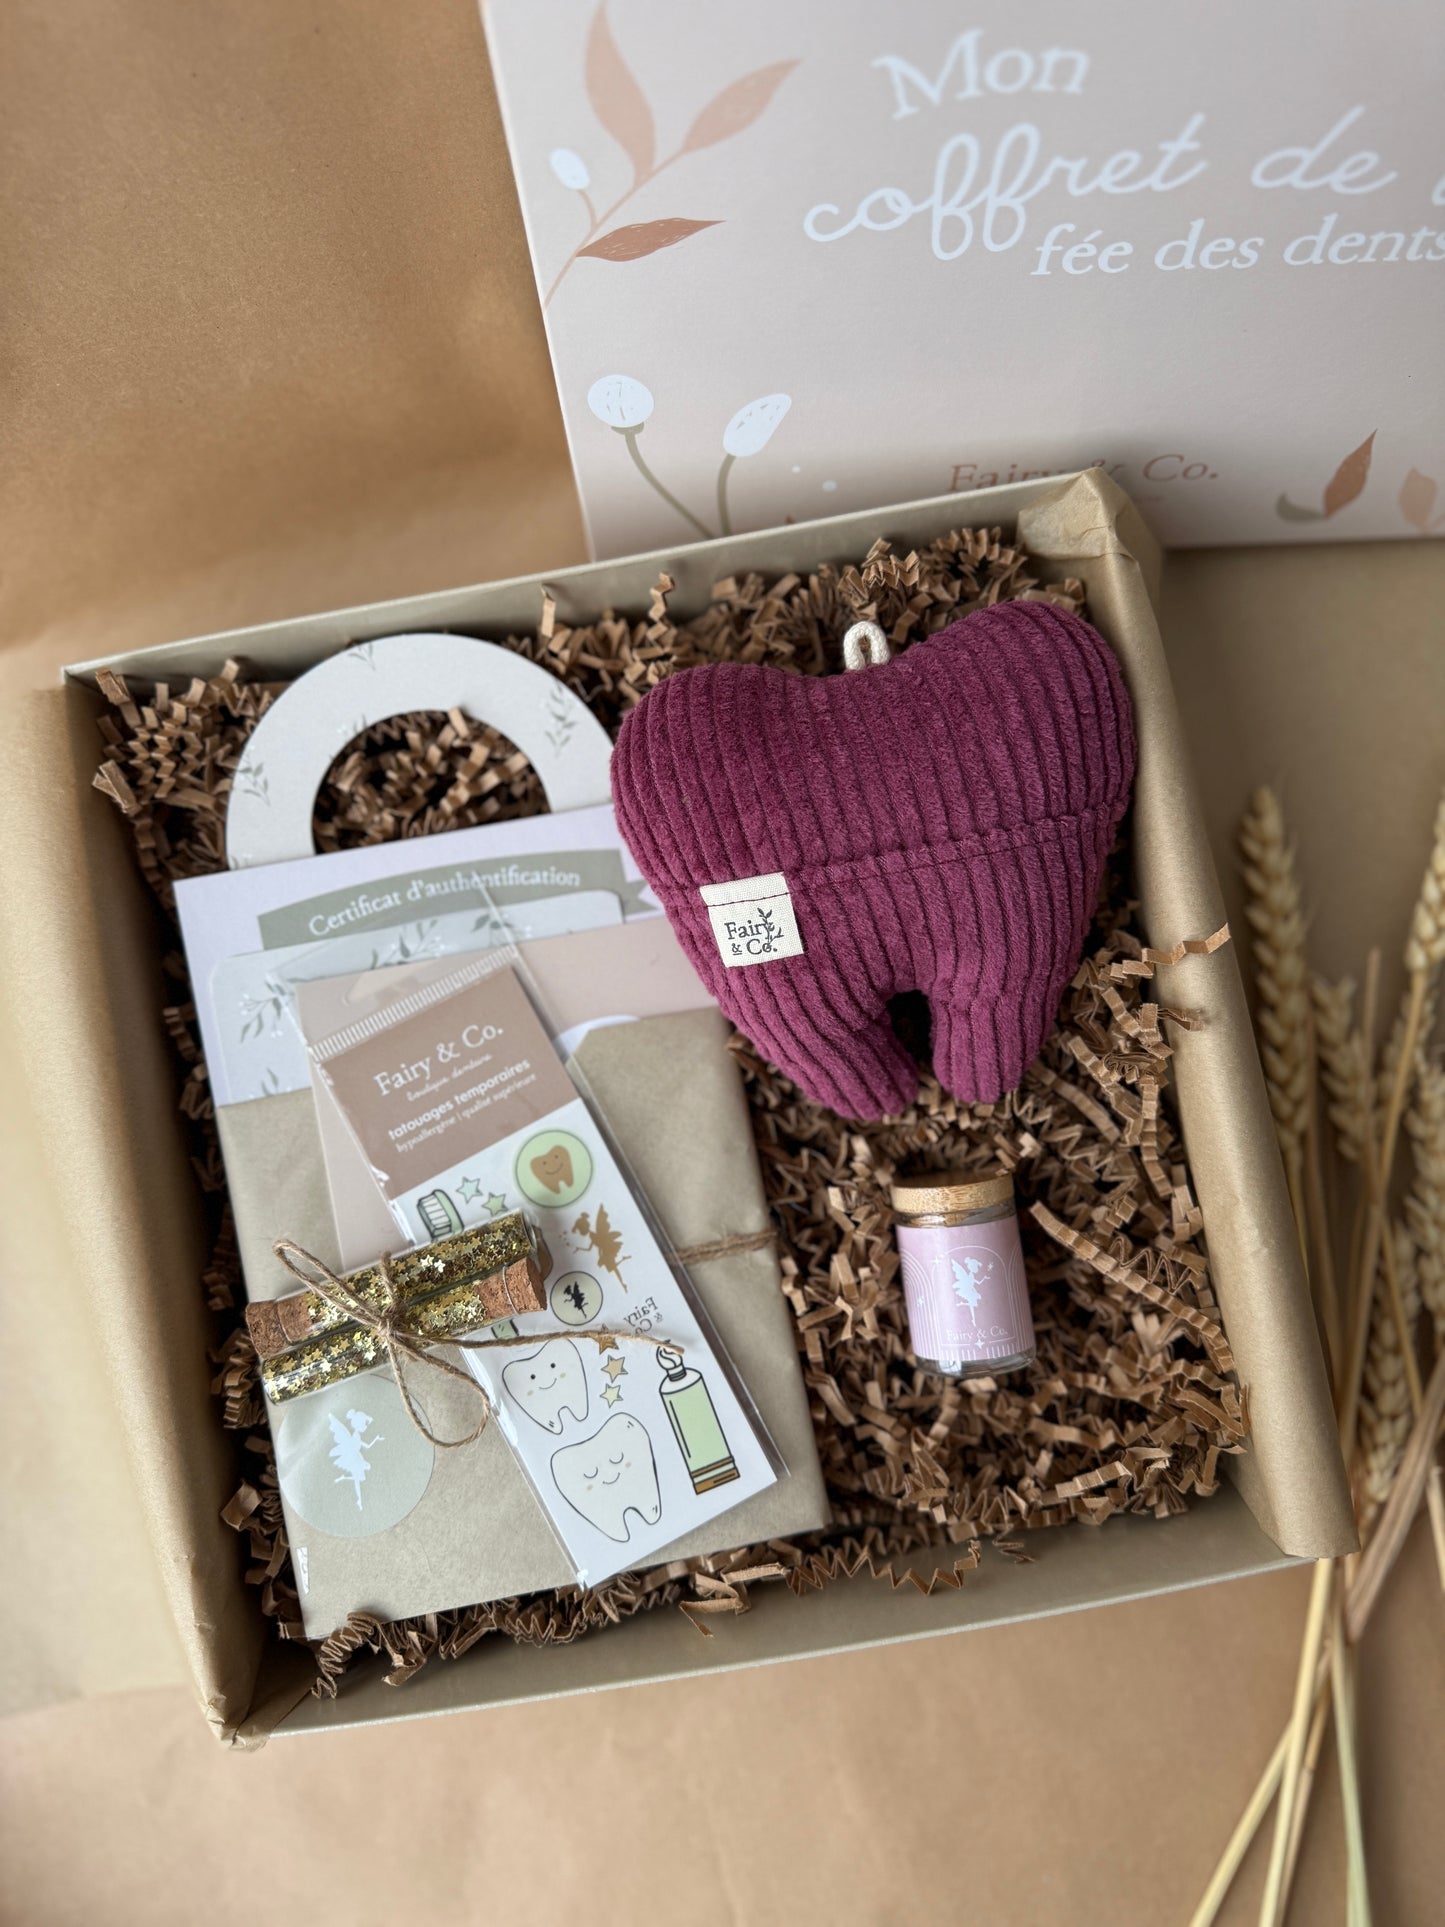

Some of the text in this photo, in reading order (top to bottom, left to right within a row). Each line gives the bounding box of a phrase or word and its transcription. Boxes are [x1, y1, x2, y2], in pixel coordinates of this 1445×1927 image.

[871, 27, 1091, 120] Mon
[802, 105, 1398, 262] coffret de
[1030, 222, 1135, 276] fée
[1154, 218, 1265, 272] des
[1142, 454, 1218, 482] Co.
[308, 892, 402, 937] Certificat
[373, 1024, 504, 1096] Fairy & Co.
[388, 1059, 531, 1140] tatouages temporaires
